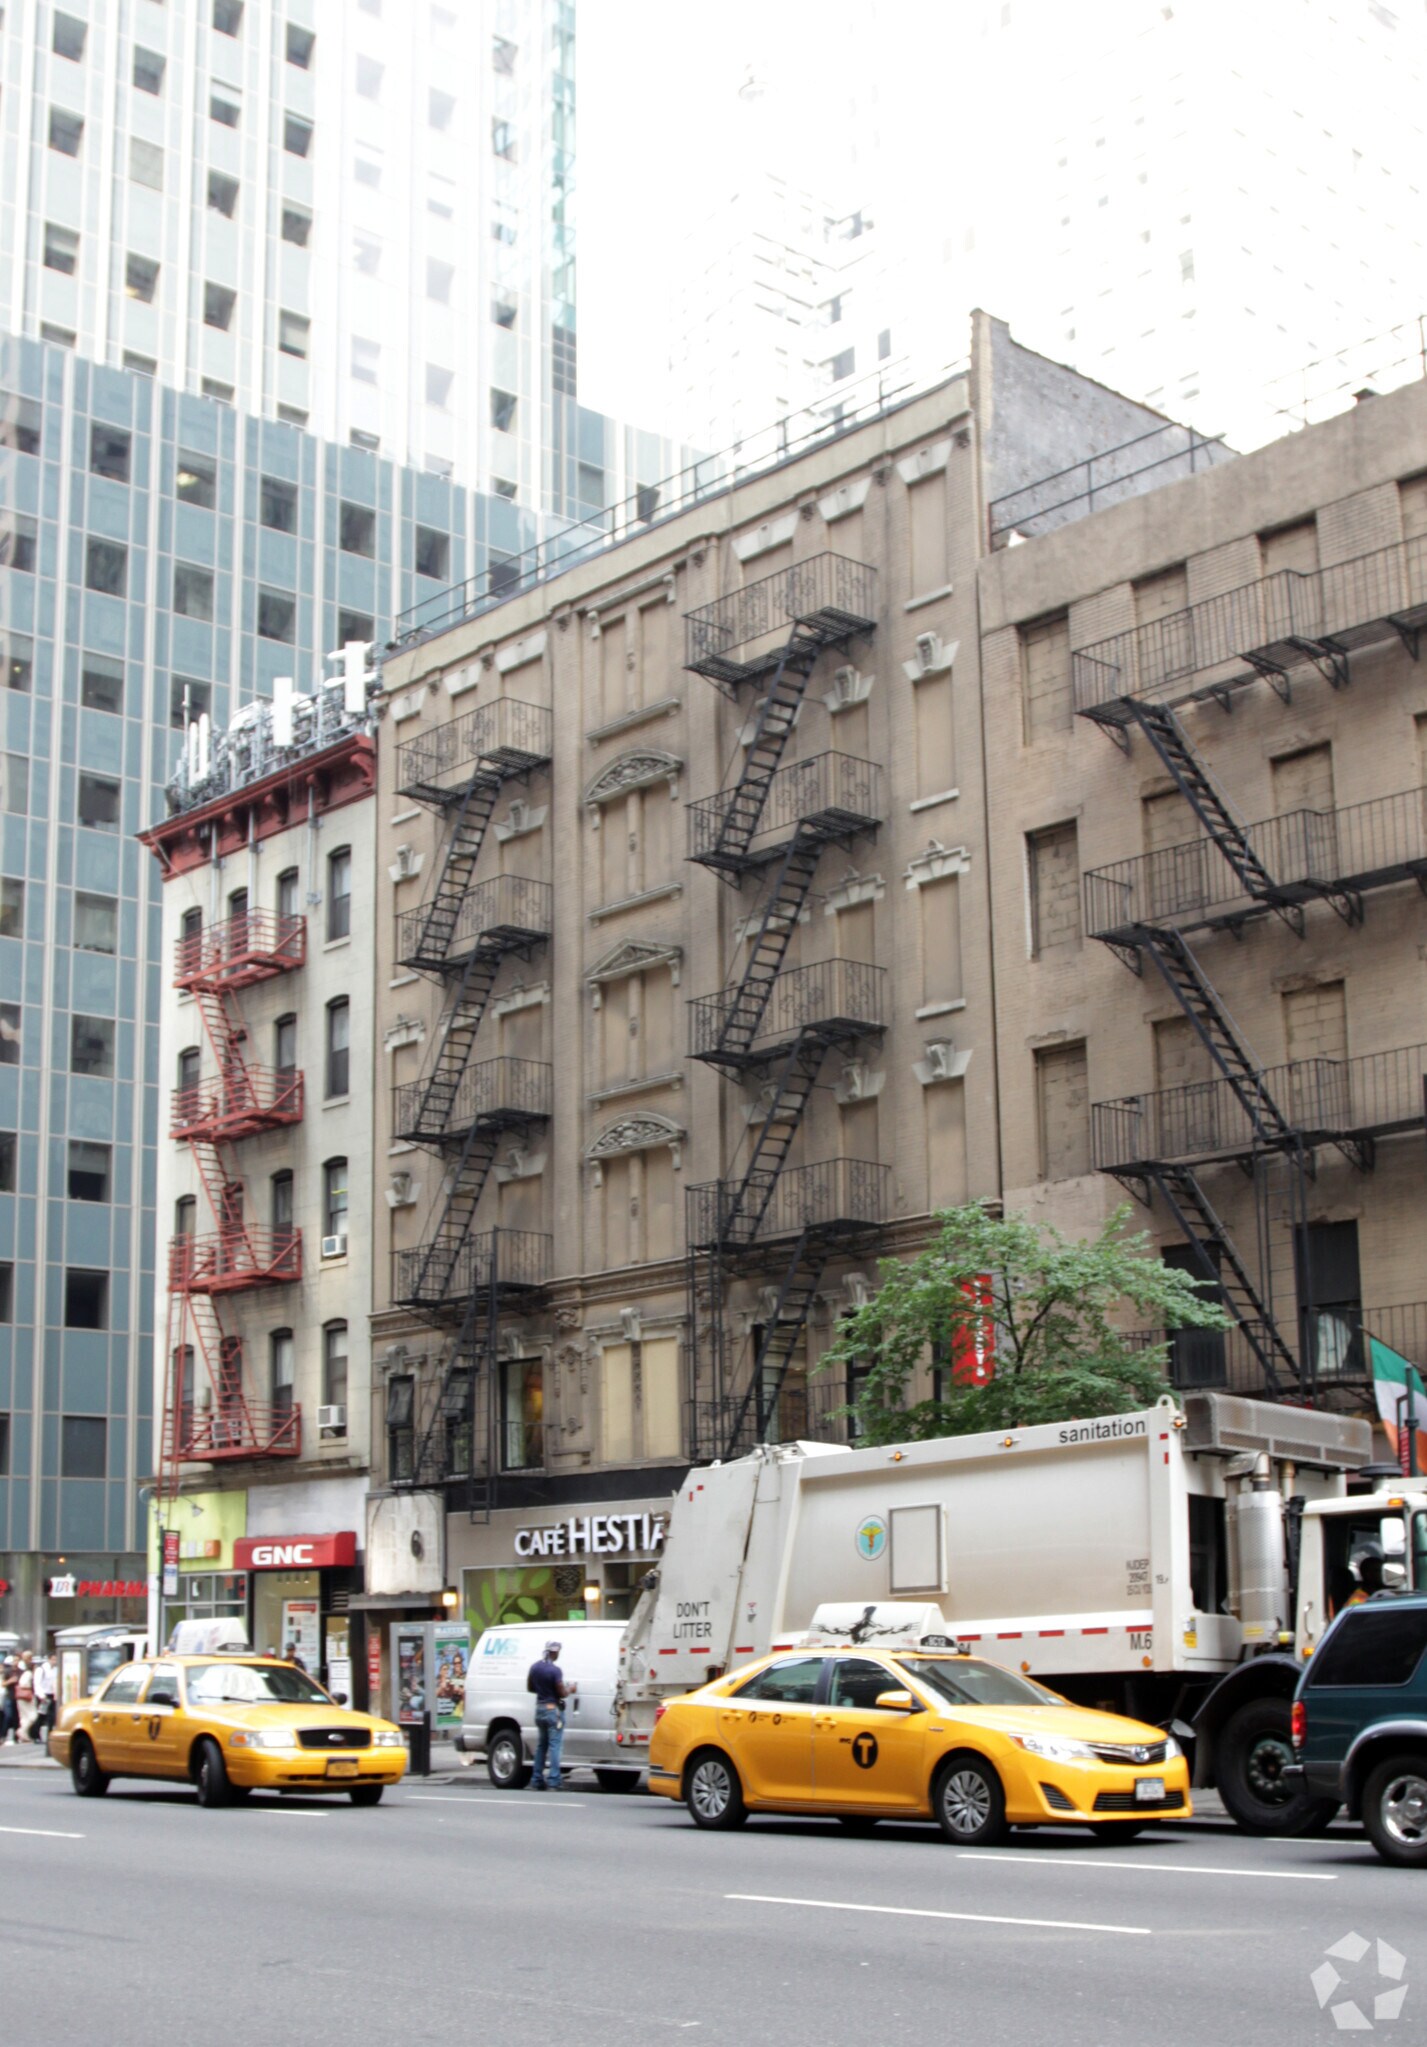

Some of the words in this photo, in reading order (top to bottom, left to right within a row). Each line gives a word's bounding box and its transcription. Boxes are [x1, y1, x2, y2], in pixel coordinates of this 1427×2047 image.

[1059, 1420, 1146, 1443] sanitation
[514, 1523, 565, 1556] CAFÉ
[252, 1544, 313, 1565] GNC
[677, 1601, 710, 1618] DON'T
[673, 1622, 712, 1639] LITTER
